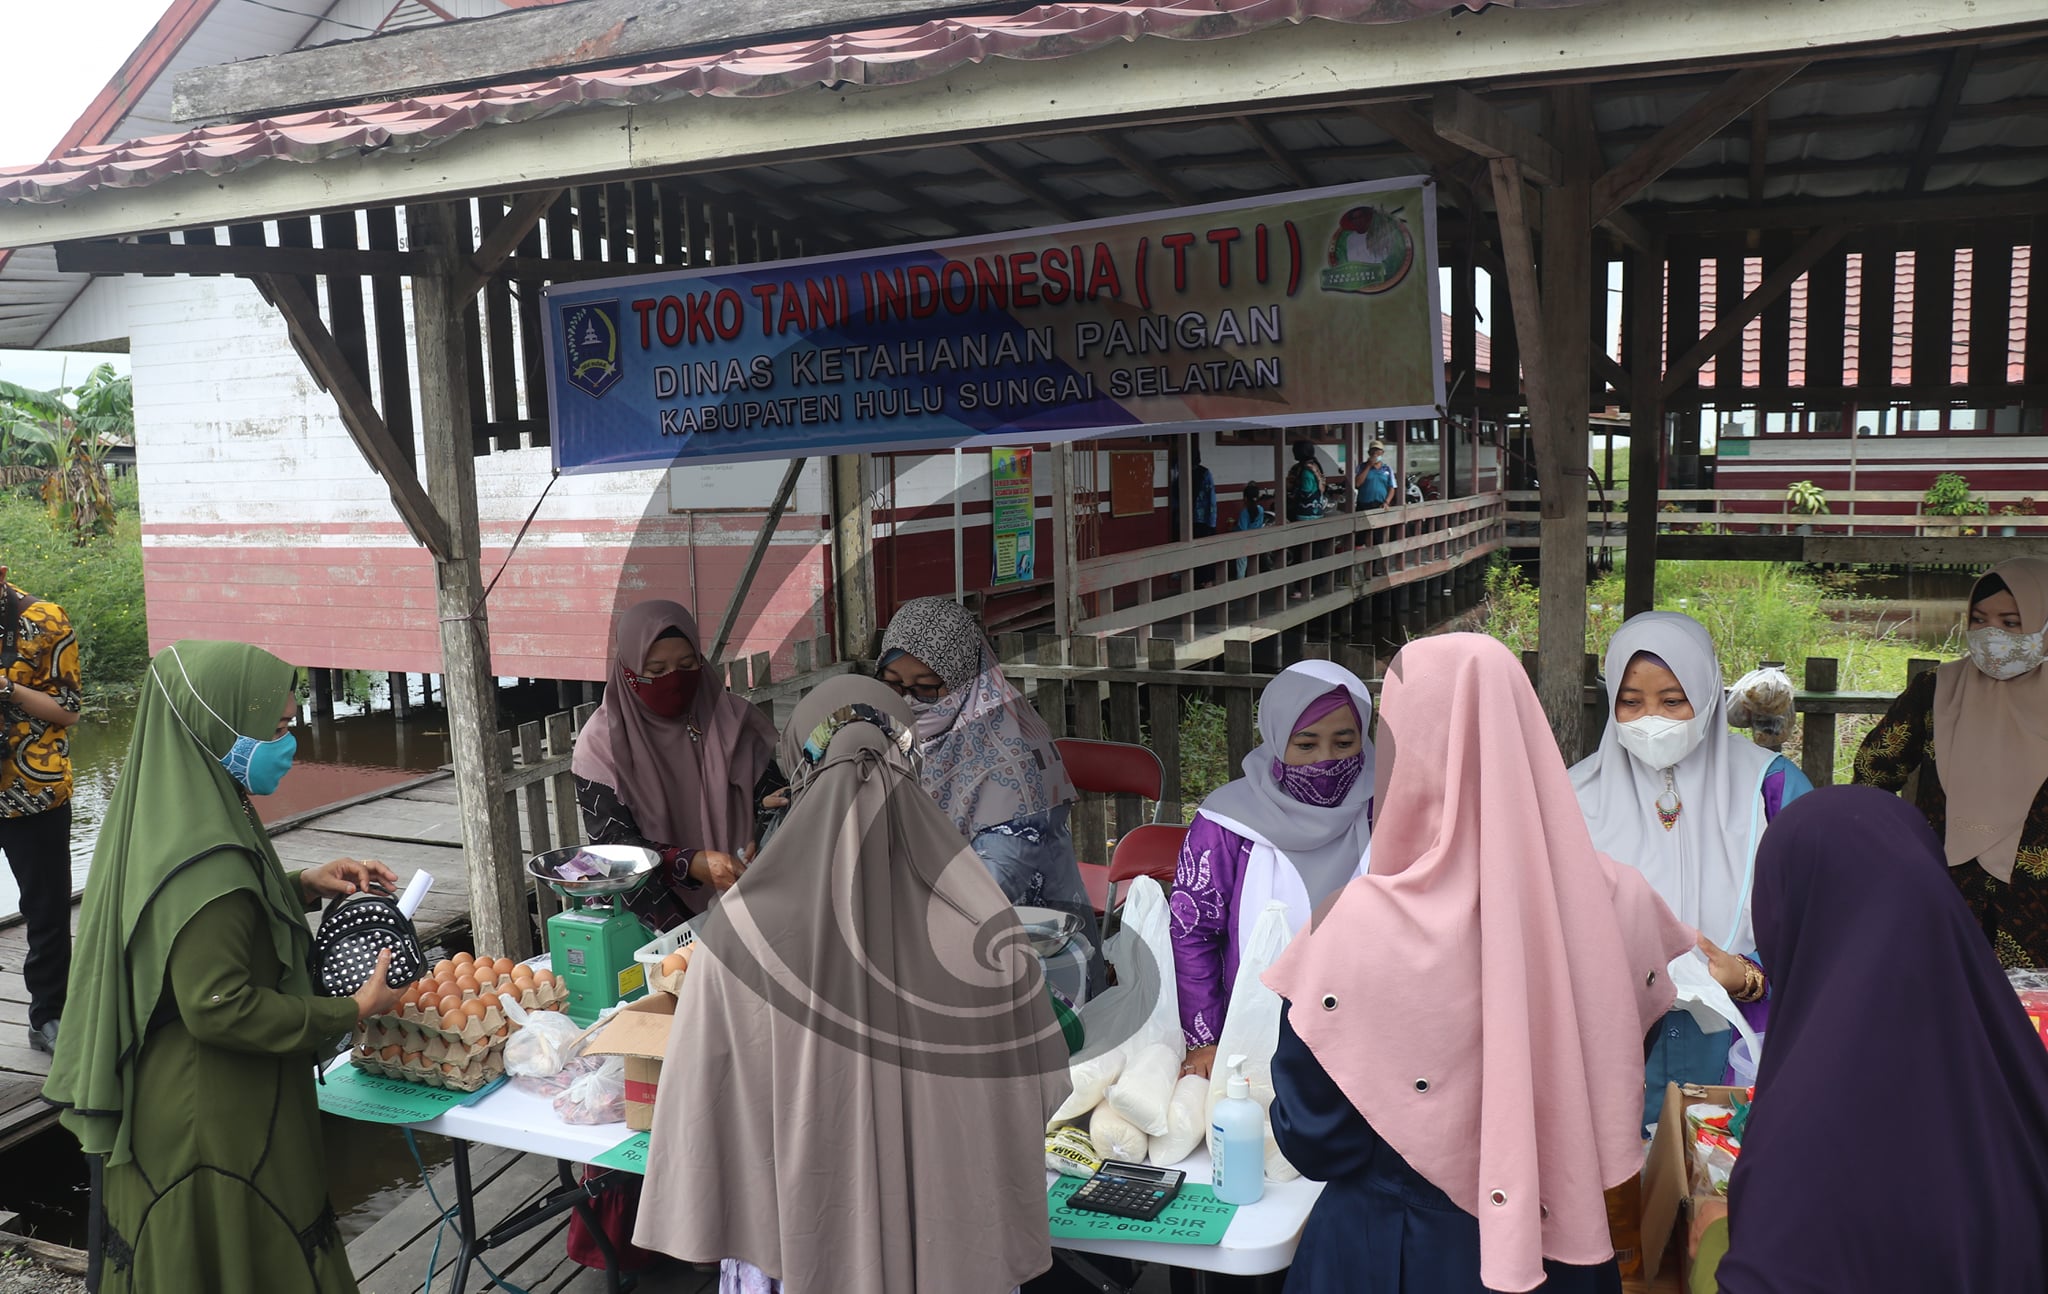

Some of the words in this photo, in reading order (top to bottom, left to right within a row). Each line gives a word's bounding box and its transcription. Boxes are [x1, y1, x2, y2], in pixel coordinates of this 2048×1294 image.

[632, 287, 744, 350] TOKO
[751, 273, 850, 336] TANI
[861, 241, 1122, 326] INDONESIA
[654, 355, 775, 400] DINAS
[791, 325, 1054, 387] KETAHANAN
[1076, 303, 1282, 360] PANGAN
[660, 394, 841, 436] KABUPATEN
[855, 384, 944, 420] HULU
[958, 372, 1093, 410] SUNGAI
[1110, 356, 1282, 399] SELATAN
[361, 1081, 417, 1095] 23.000
[425, 1093, 454, 1102] KG
[363, 1102, 431, 1119] KOMODITAS
[622, 1149, 642, 1162] Rp.
[1052, 1145, 1094, 1166] GARAM
[1048, 1216, 1077, 1228] Rp.
[1087, 1220, 1153, 1235] 12.000
[1171, 1229, 1201, 1238] KG
[1138, 1214, 1207, 1229] ASIR
